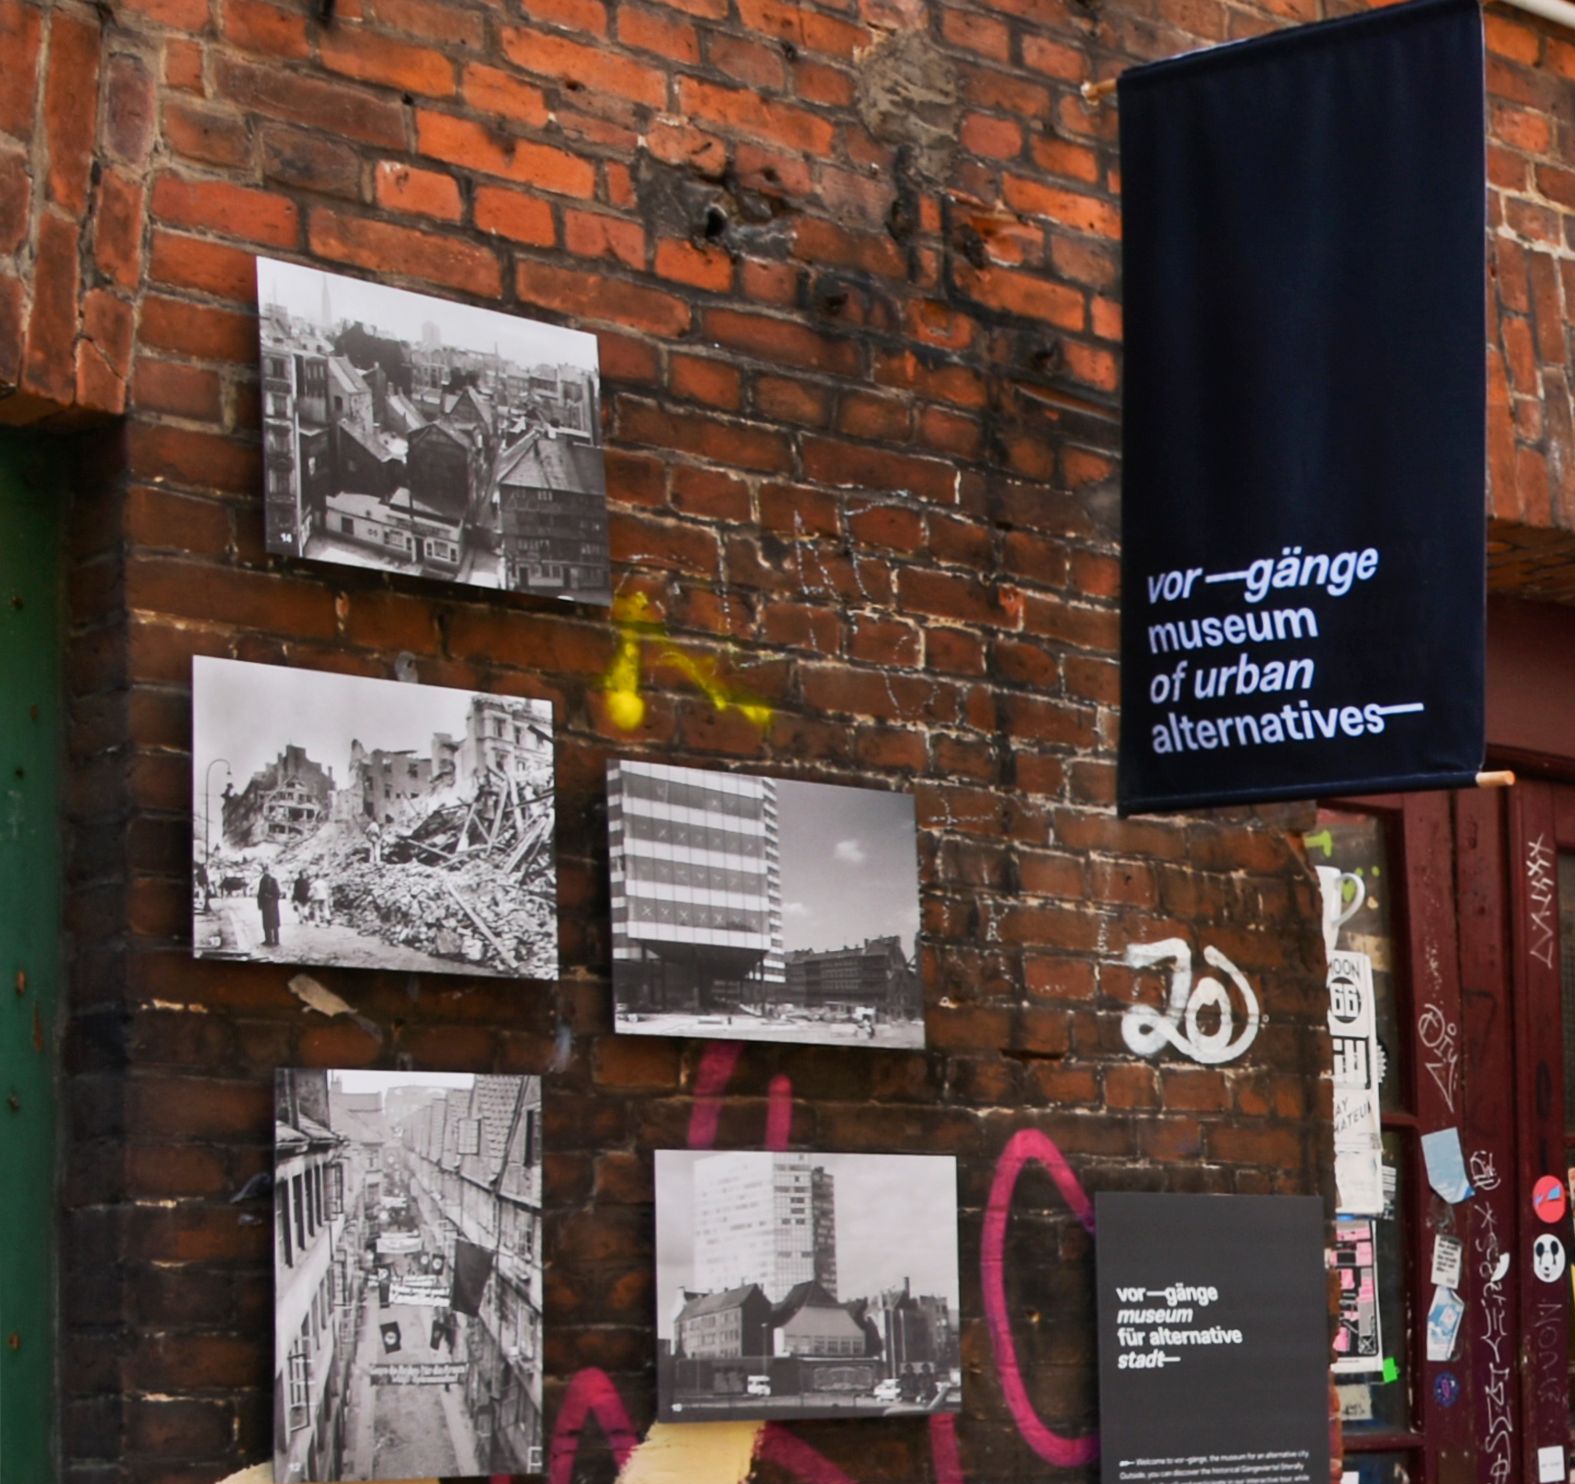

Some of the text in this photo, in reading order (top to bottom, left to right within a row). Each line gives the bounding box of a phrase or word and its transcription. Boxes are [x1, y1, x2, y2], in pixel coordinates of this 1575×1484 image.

[1148, 606, 1318, 654] museum
[1150, 653, 1315, 704] of urban
[1329, 958, 1361, 978] OON
[1117, 1306, 1193, 1324] museum
[1117, 1325, 1243, 1347] für alternative
